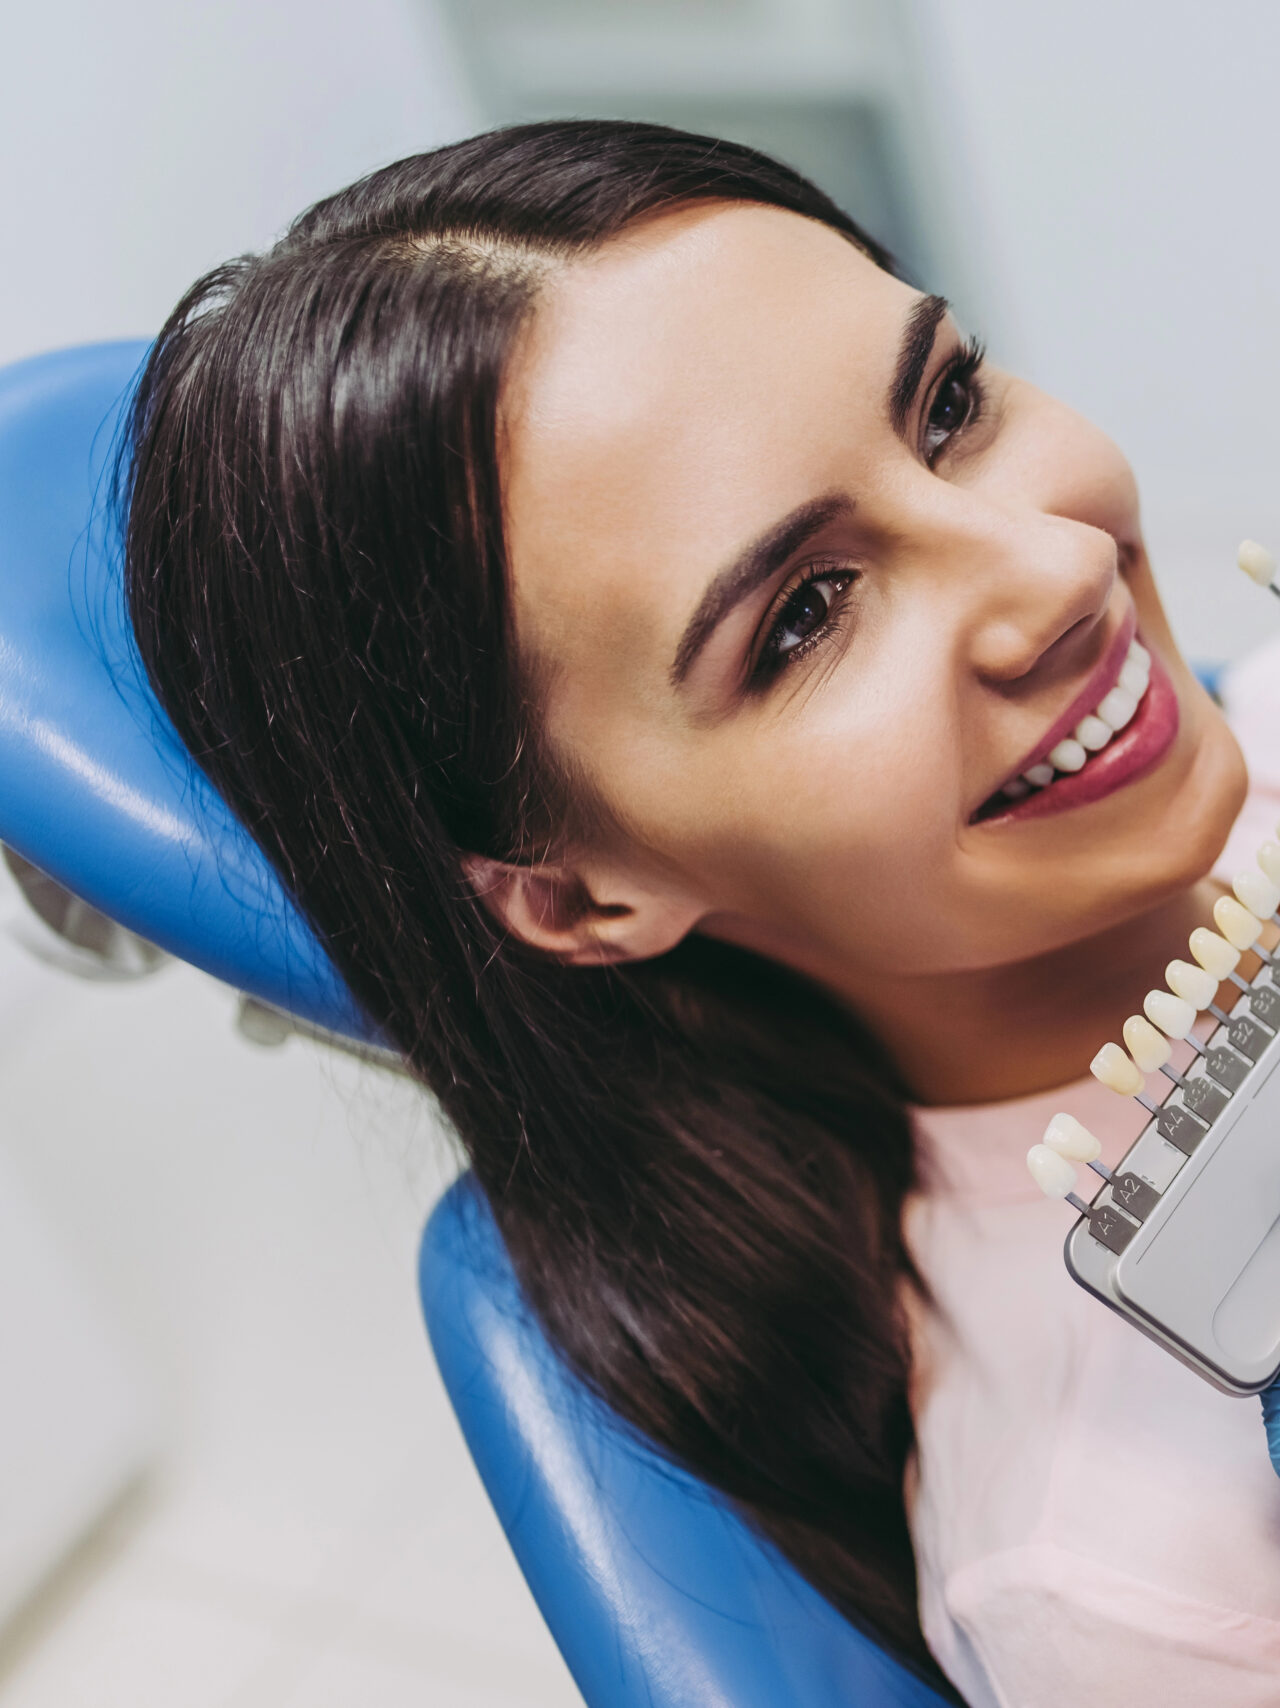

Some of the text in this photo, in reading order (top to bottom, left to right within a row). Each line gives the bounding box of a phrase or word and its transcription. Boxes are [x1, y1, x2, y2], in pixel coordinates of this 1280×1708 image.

[1232, 1022, 1254, 1045] B2
[1164, 1111, 1185, 1136] A4
[1119, 1178, 1141, 1204] A2
[1098, 1212, 1117, 1236] A1
